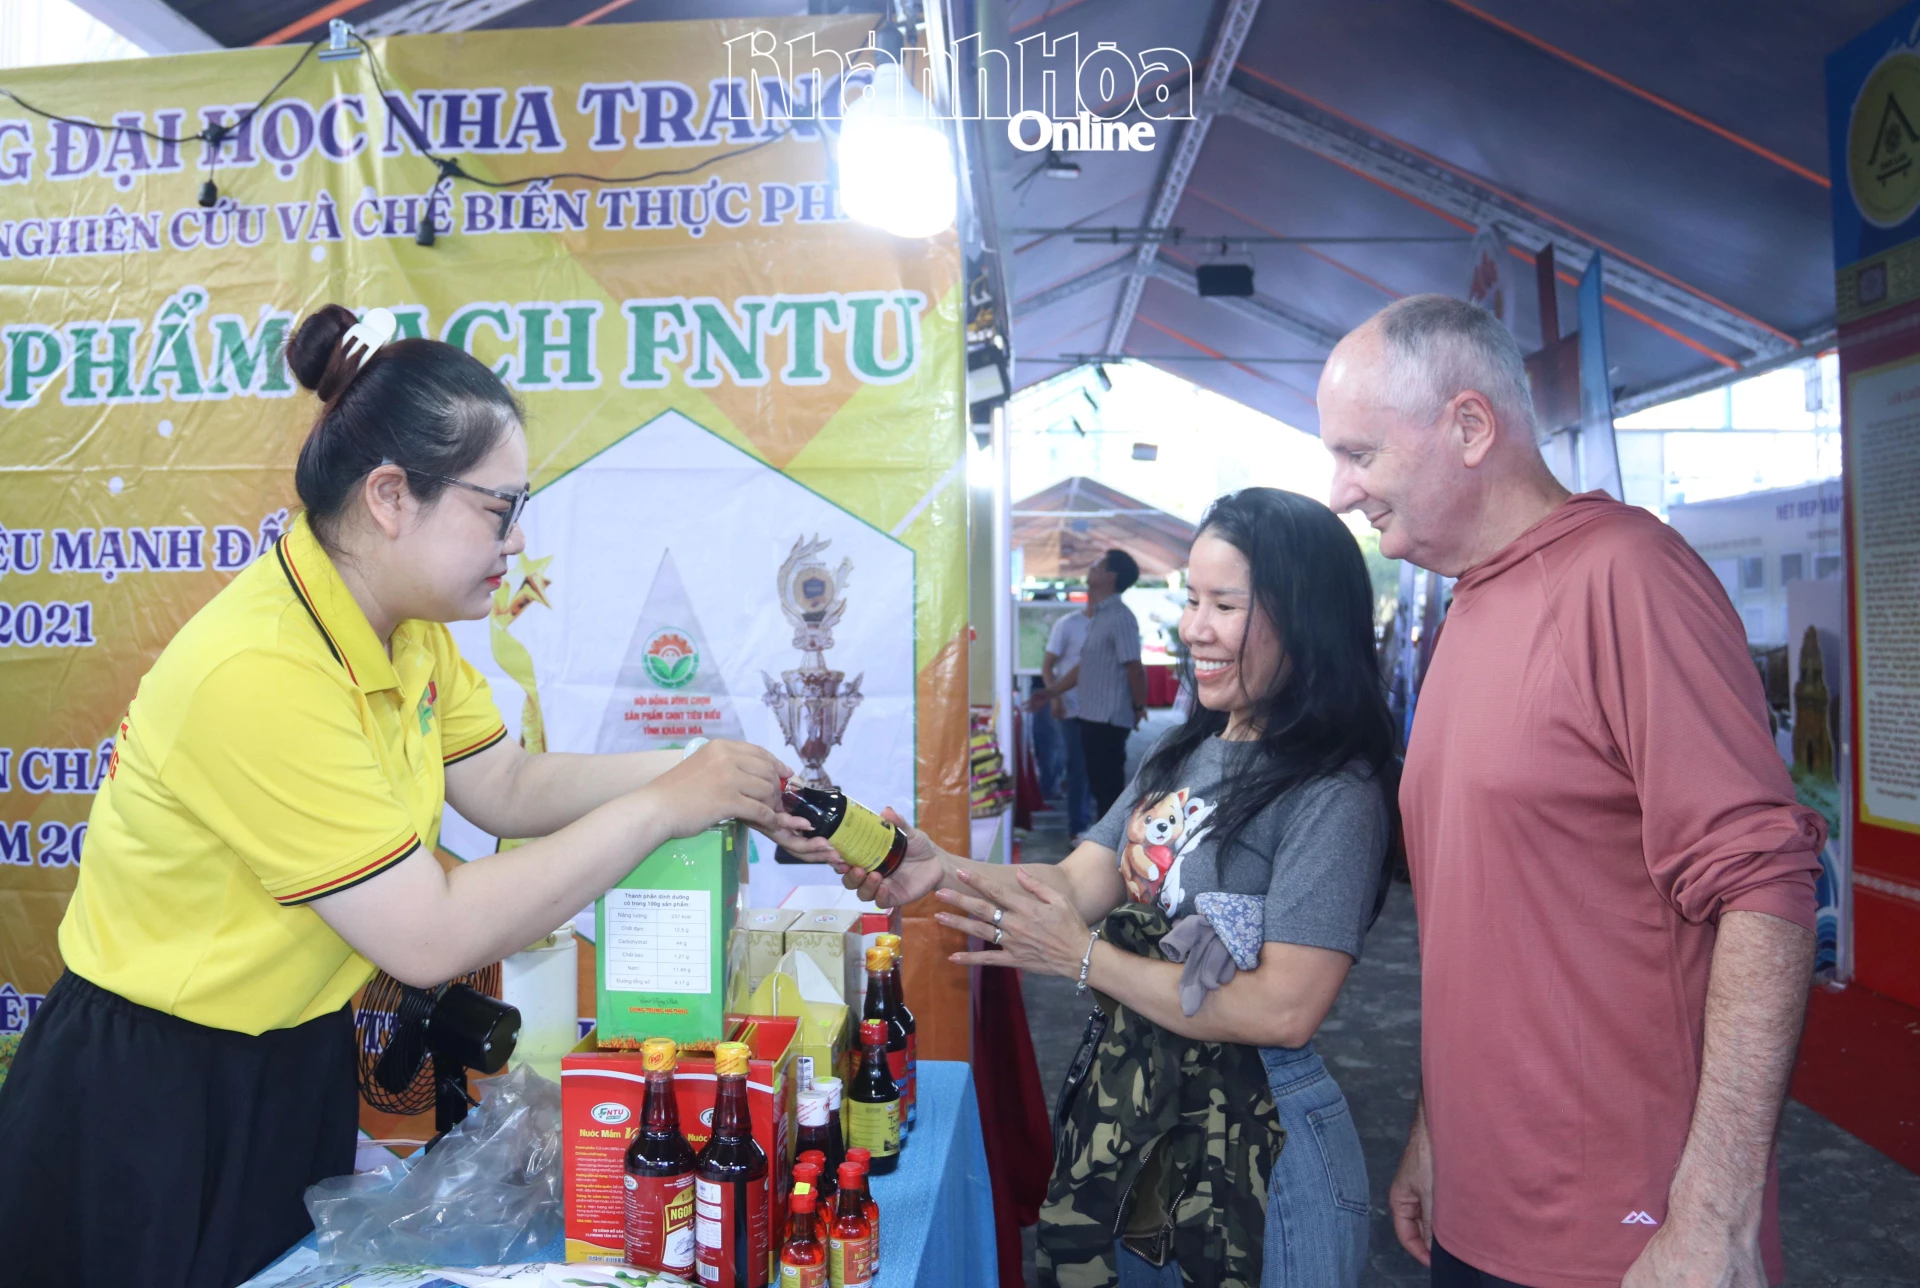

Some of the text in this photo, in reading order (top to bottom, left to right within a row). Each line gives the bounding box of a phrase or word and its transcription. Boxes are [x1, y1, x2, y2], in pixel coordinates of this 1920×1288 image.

[50, 113, 182, 187] ĐẠI
[201, 98, 366, 177] HỌC
[382, 91, 561, 152] NHA
[170, 199, 267, 248] CỨU
[276, 193, 342, 241] VÀ
[352, 181, 453, 238] CHẾ
[464, 178, 587, 232] BIẾN
[599, 179, 749, 236] THỰC
[4, 291, 292, 401] PHẨM
[626, 296, 922, 382] FNTU
[52, 530, 202, 580] MẠNH
[579, 1128, 600, 1138] Nước
